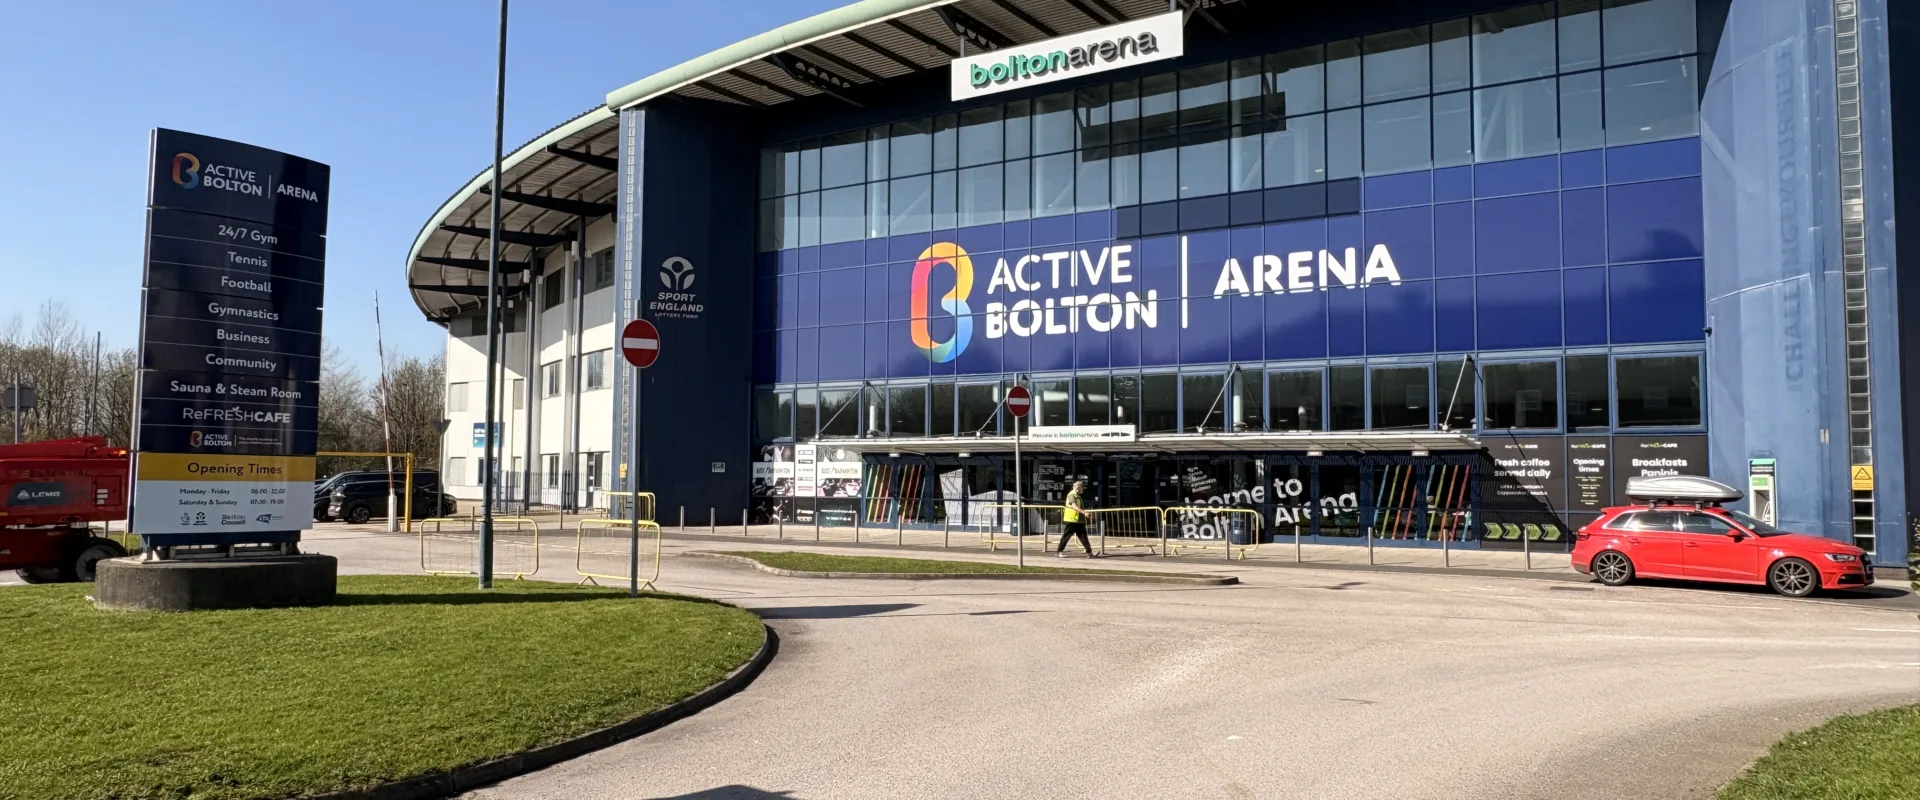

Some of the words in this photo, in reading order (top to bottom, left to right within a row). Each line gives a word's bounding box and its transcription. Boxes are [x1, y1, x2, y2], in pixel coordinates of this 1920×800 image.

[970, 31, 1158, 88] boltonarena
[204, 163, 256, 183] ACTIVE
[203, 175, 262, 196] BOLTON
[277, 183, 318, 203] ARENA
[218, 224, 247, 240] 24/7
[250, 230, 278, 245] Gym
[227, 251, 268, 267] Tennis
[987, 244, 1133, 295] ACTIVE
[1213, 243, 1401, 299] ARENA
[221, 276, 272, 293] Football
[658, 292, 696, 301] SPORT
[208, 302, 279, 321] Gymnastics
[650, 302, 704, 312] ENGLAND
[985, 289, 1158, 340] BOLTON
[216, 329, 270, 344] Business
[205, 353, 277, 372] Community
[170, 380, 211, 394] Sauna
[215, 384, 226, 394] &
[230, 384, 267, 397] Steam
[271, 387, 302, 399] Room
[188, 462, 244, 476] Opening
[248, 463, 282, 474] Times
[1521, 458, 1550, 466] coffee
[1573, 458, 1605, 467] Opening
[1632, 458, 1688, 467] Breakfasts
[1527, 469, 1551, 479] daily
[180, 488, 206, 496] Monday
[211, 488, 230, 496] Friday
[1273, 478, 1303, 499] to
[178, 499, 207, 507] Saturday
